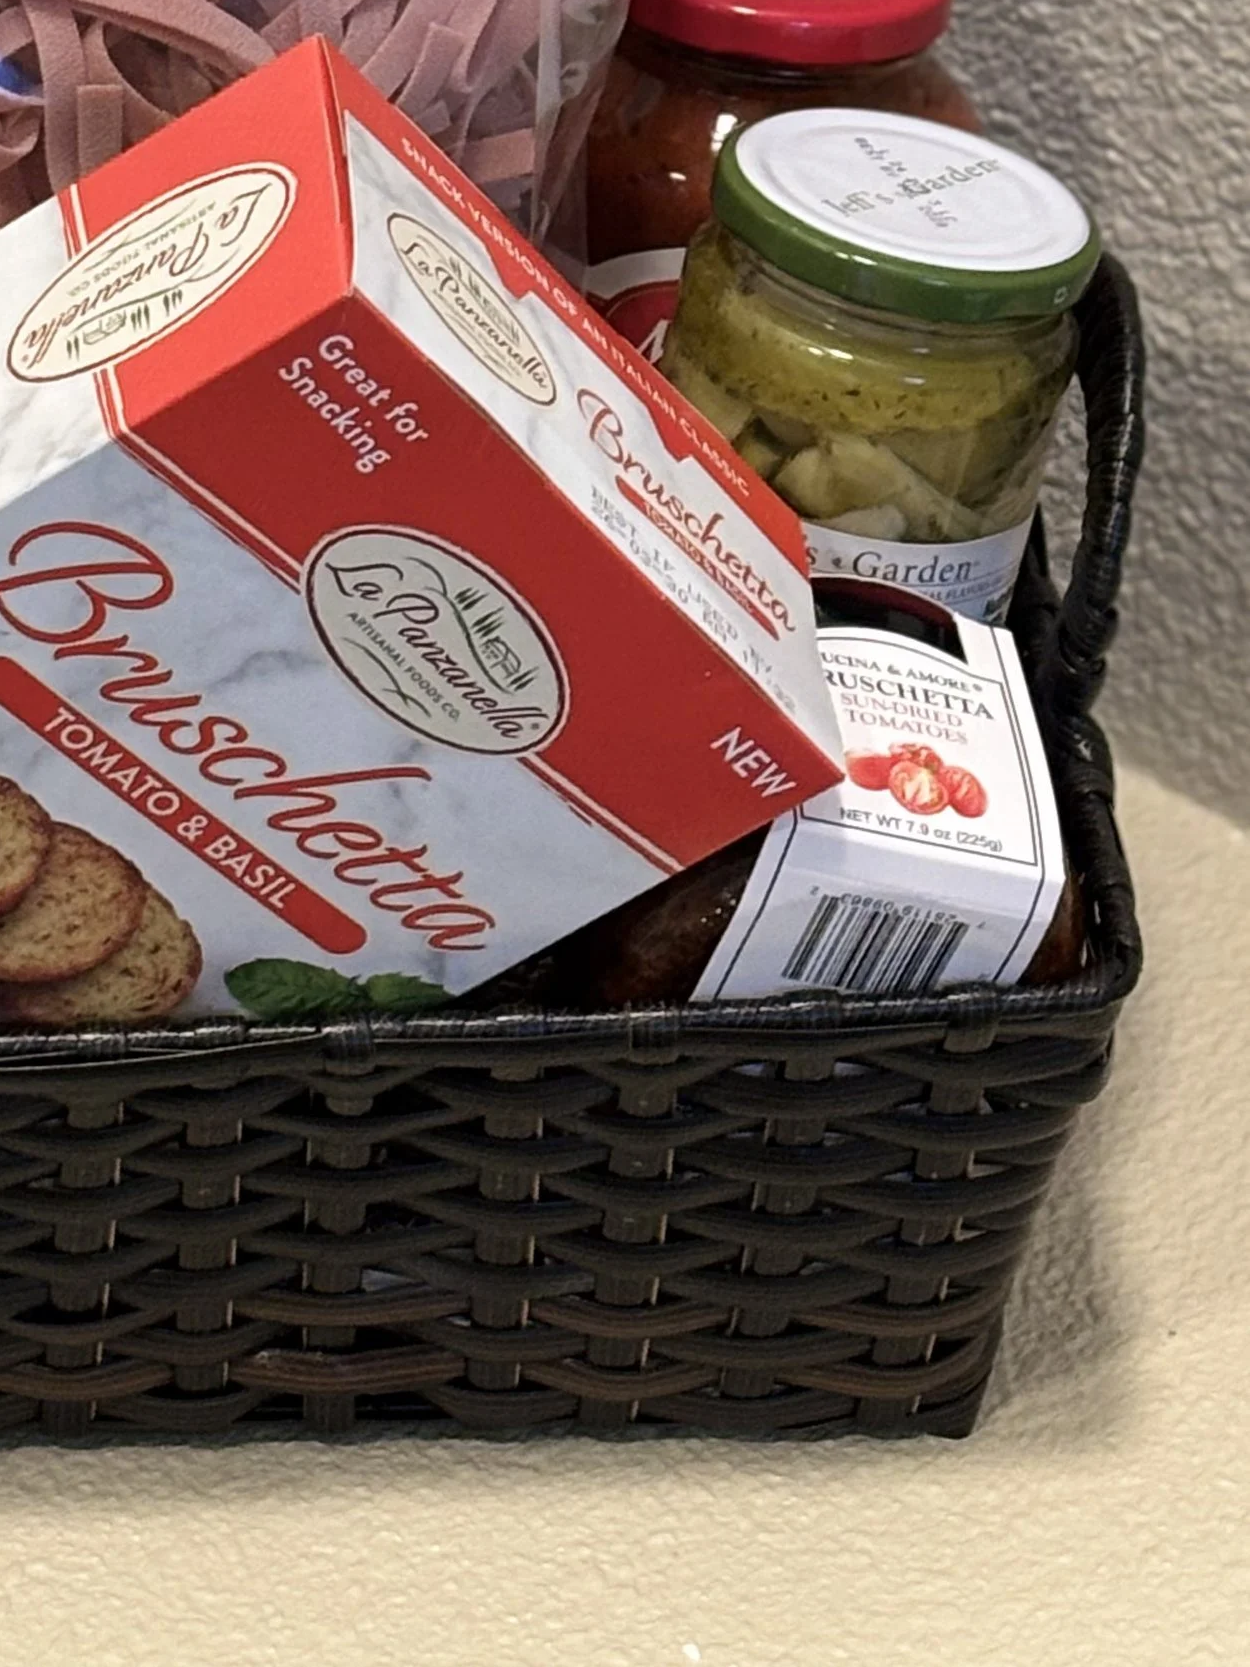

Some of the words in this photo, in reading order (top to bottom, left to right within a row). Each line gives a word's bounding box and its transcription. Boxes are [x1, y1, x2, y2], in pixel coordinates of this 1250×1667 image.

[218, 182, 273, 247] La
[25, 221, 209, 368] Panzanella
[401, 242, 433, 276] La
[434, 265, 548, 390] Panzanella
[402, 137, 465, 209] SNACK
[468, 202, 549, 291] VERSION
[552, 287, 577, 316] OF
[611, 346, 676, 422] ITALIAN
[680, 418, 749, 497] CLASSIC
[278, 356, 391, 474] Snacking
[318, 334, 390, 407] Great
[385, 402, 428, 444] for
[578, 388, 796, 632] Bruschetta
[852, 551, 972, 584] Garden
[325, 562, 404, 601] La
[373, 593, 549, 738] Panzanella
[347, 612, 406, 669] ARTISANAL
[405, 666, 444, 704] FOODS
[821, 652, 881, 672] UCINA
[887, 665, 901, 676] &
[823, 669, 994, 720] RUSCHETTA
[841, 693, 962, 727] SUN-DRIED
[844, 708, 967, 744] TOMATOES
[709, 725, 798, 798] NEW
[44, 707, 181, 818] TOMATO
[176, 815, 211, 842] &
[203, 835, 298, 910] BASIL
[840, 807, 872, 820] NET
[876, 815, 901, 829] WT
[934, 829, 951, 840] oz
